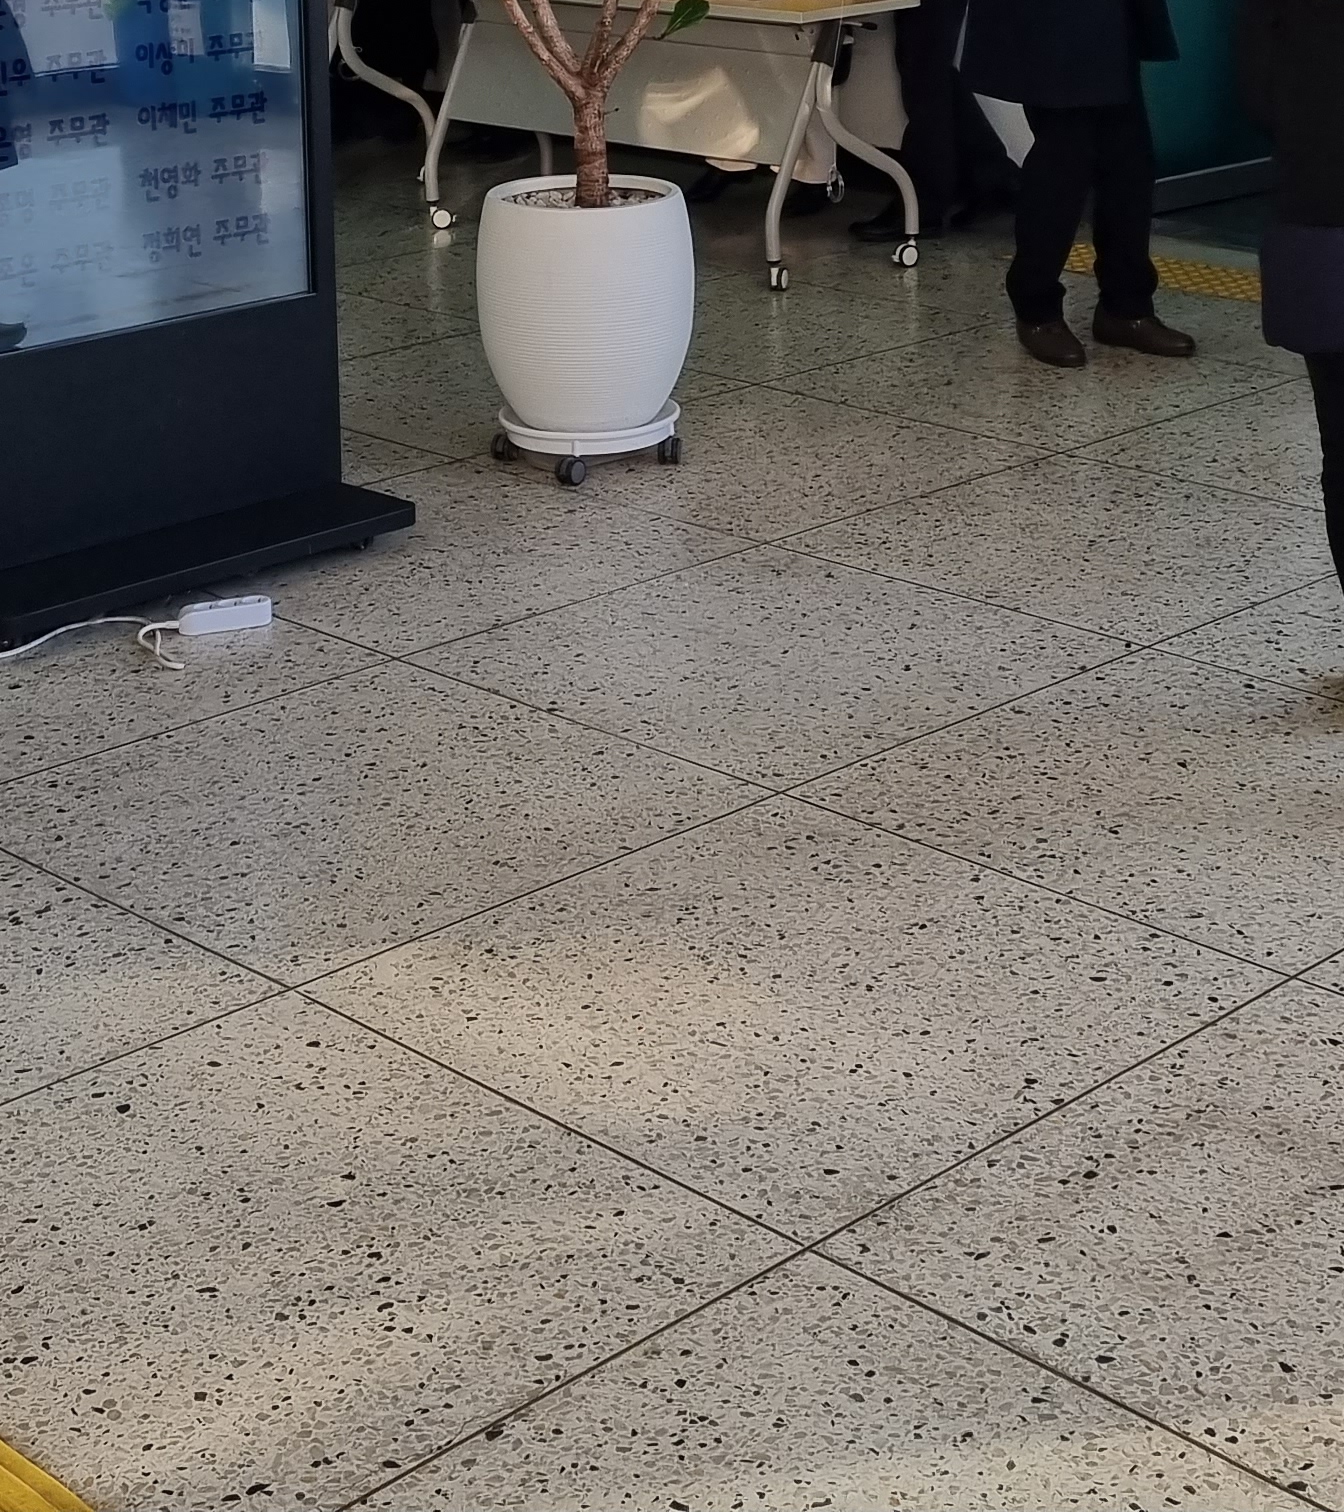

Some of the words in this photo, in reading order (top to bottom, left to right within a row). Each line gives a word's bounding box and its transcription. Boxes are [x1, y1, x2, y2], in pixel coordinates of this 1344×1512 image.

[208, 90, 268, 125] 주무관
[47, 111, 110, 147] 주무관
[212, 213, 272, 246] 주무관
